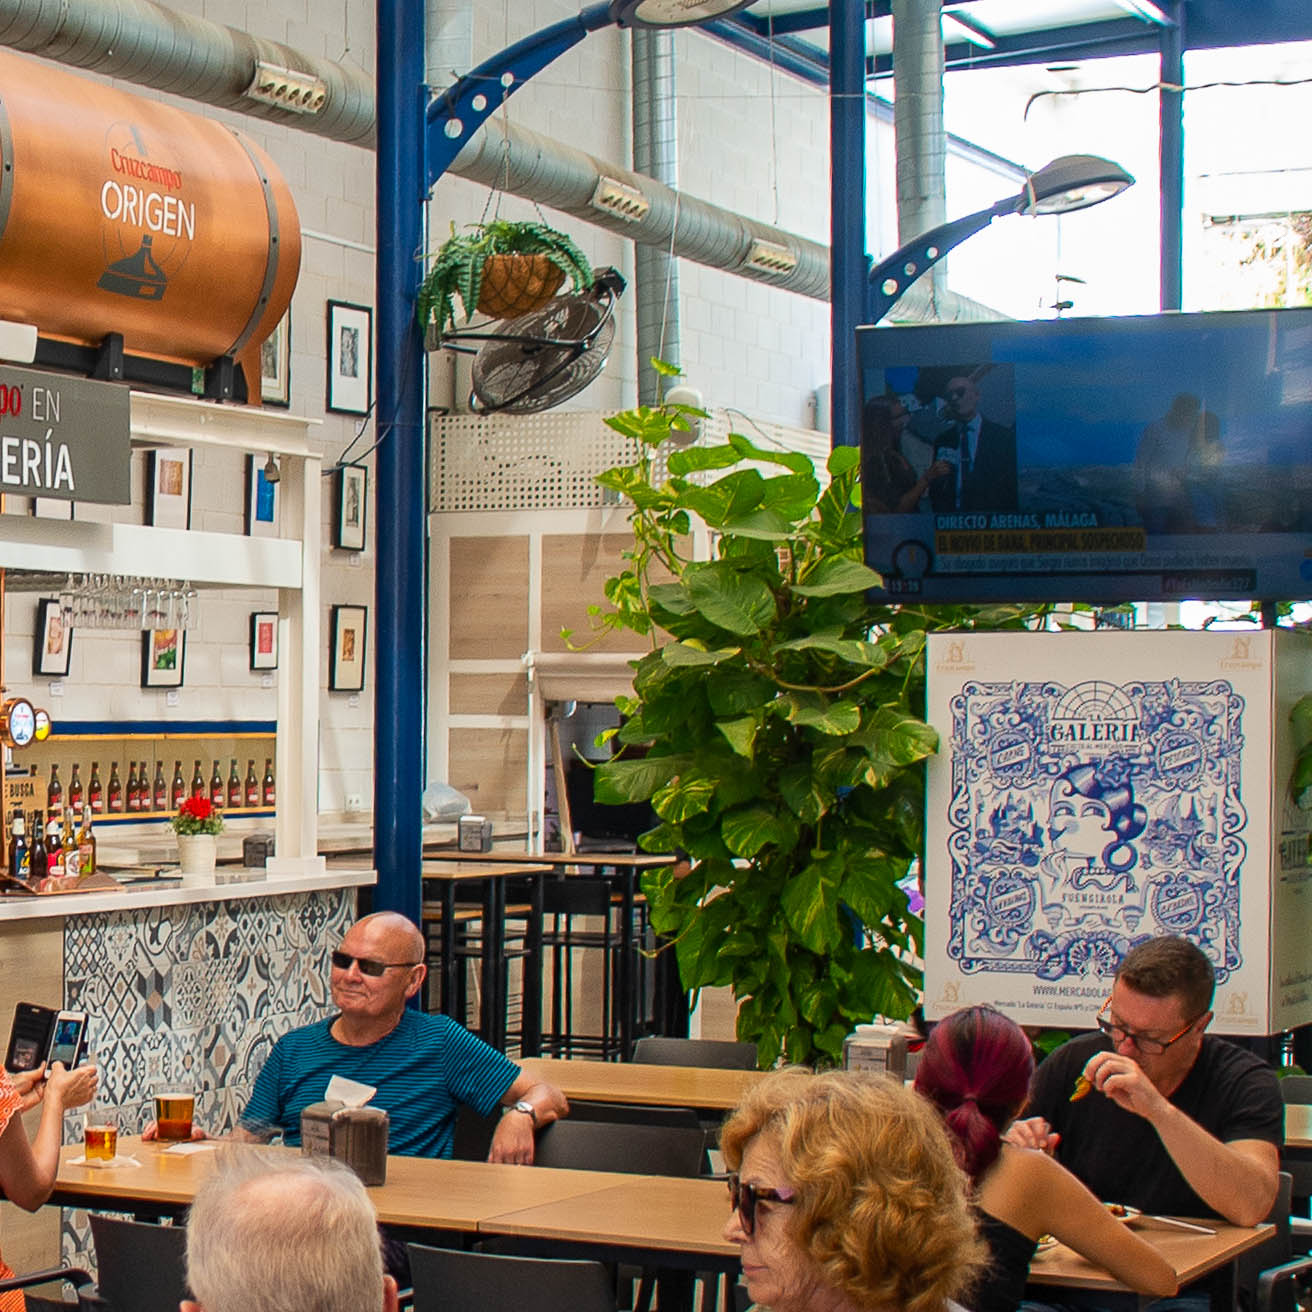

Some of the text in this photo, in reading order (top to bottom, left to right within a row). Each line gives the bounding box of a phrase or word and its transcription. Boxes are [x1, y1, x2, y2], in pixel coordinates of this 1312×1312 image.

[111, 147, 183, 193] Cruzcampo
[101, 179, 196, 241] ORIGEN
[32, 387, 62, 423] EN
[937, 509, 1098, 530] DIRECTO ARENAS, MÁLAGA
[10, 783, 34, 797] BUSCA
[1061, 892, 1125, 905] FUENGIROLA
